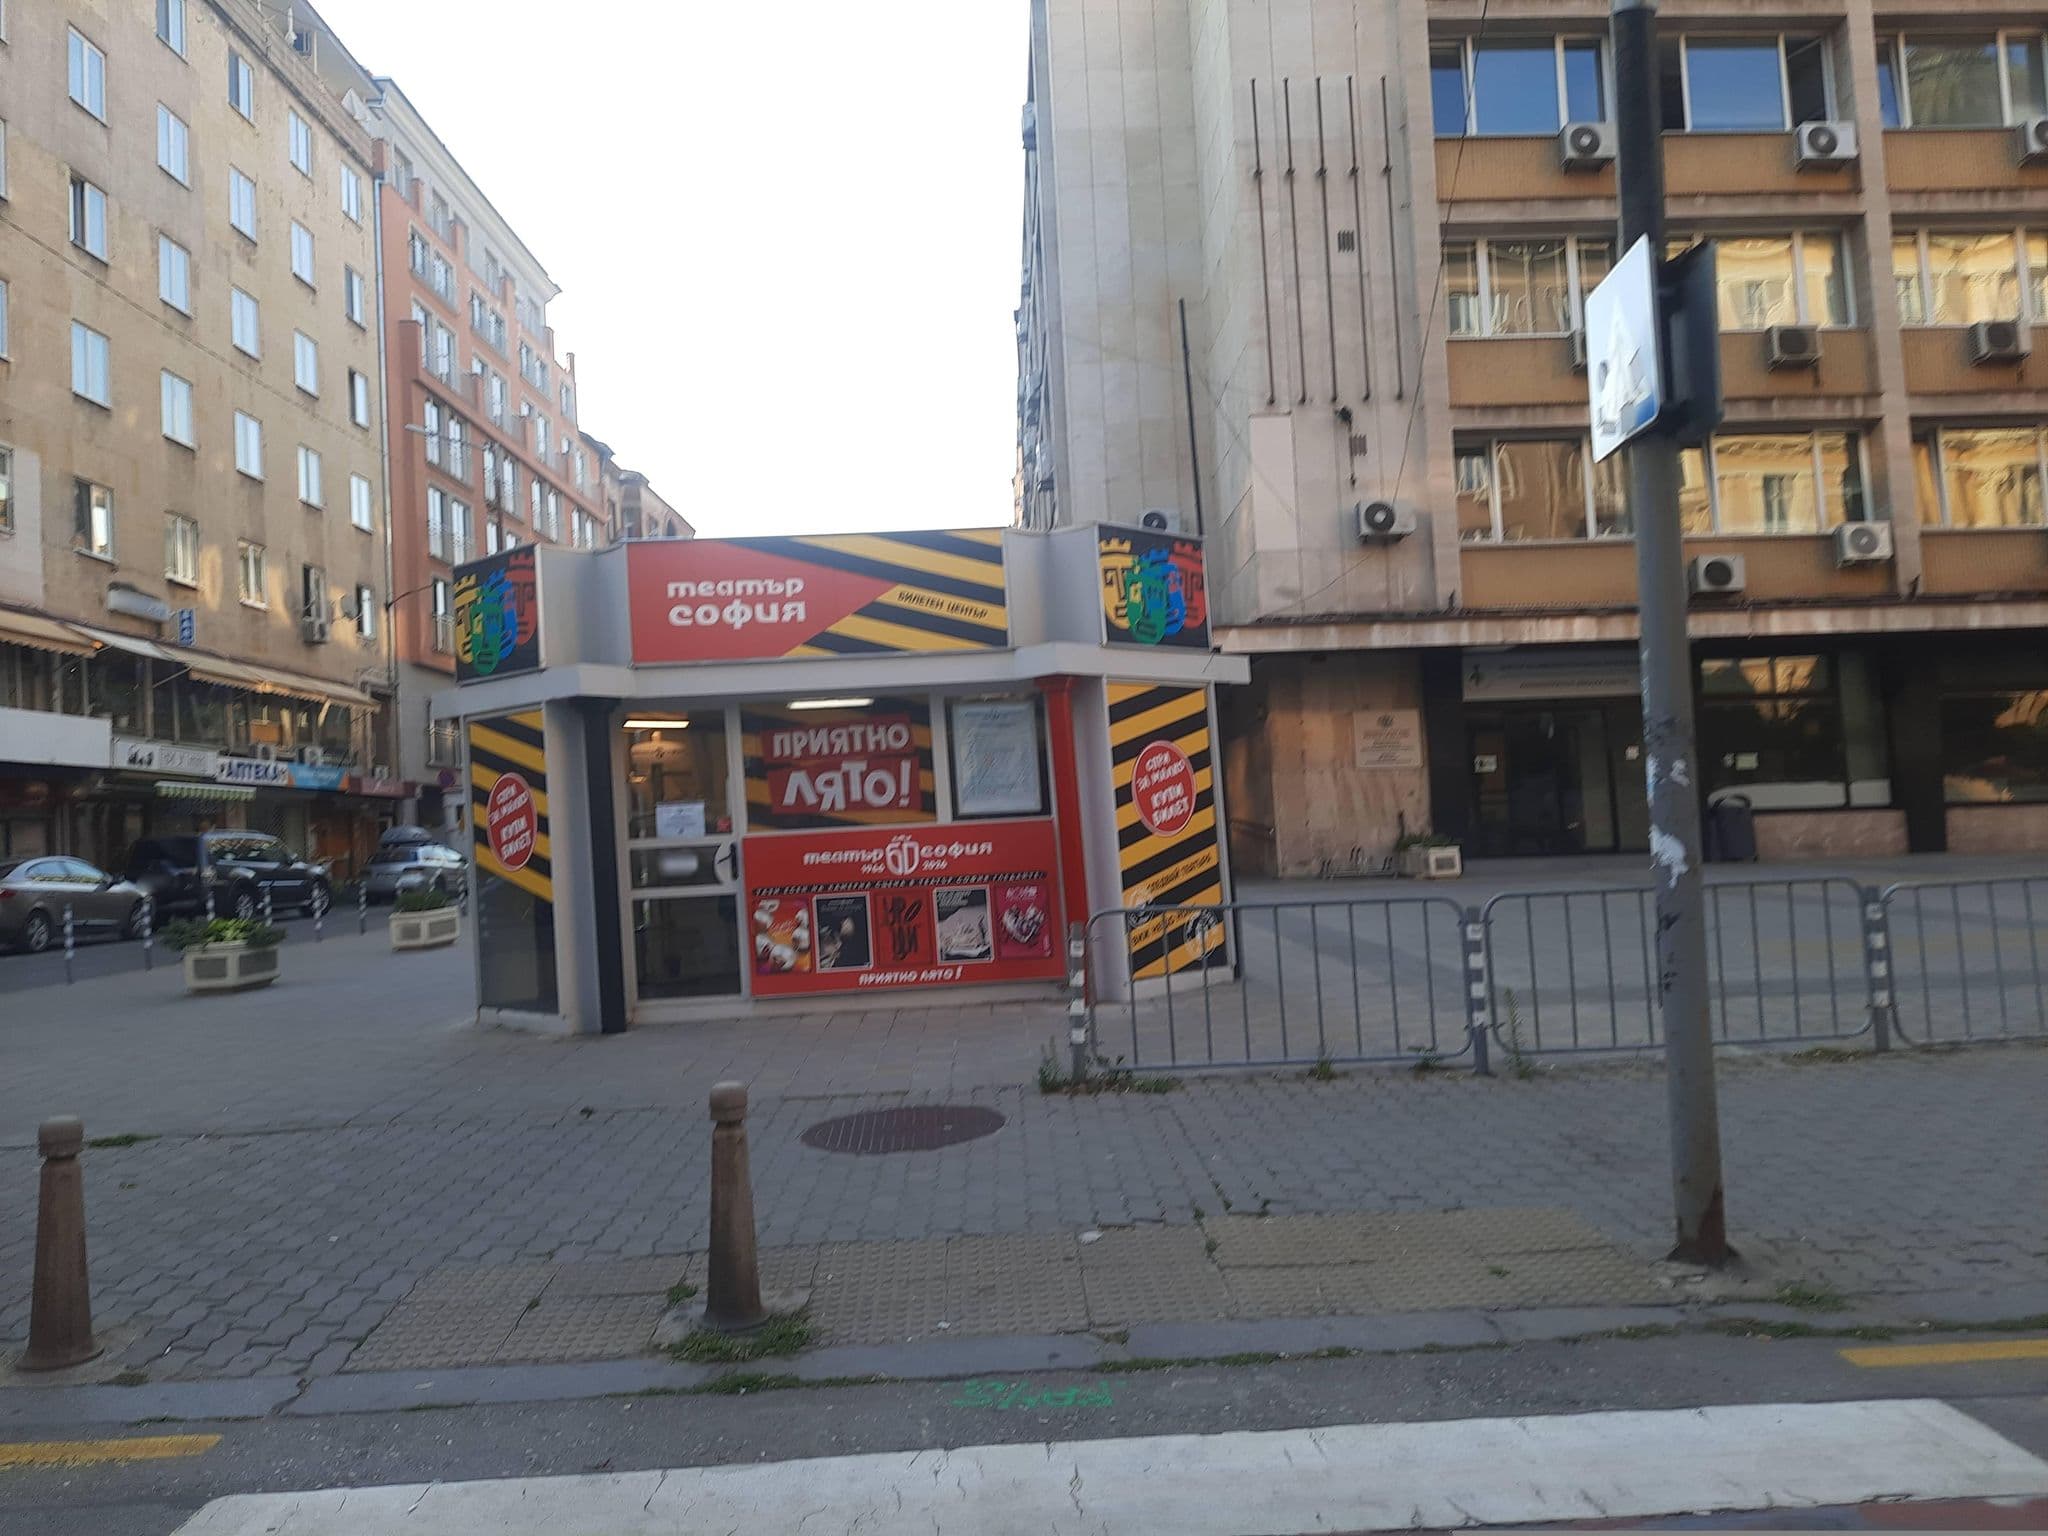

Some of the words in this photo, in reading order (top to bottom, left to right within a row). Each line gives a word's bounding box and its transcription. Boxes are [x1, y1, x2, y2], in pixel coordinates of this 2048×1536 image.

[667, 577, 805, 598] театър
[668, 598, 807, 630] софия
[772, 722, 911, 759] ПРИЯТНО
[781, 759, 912, 812] ЛЯТО!
